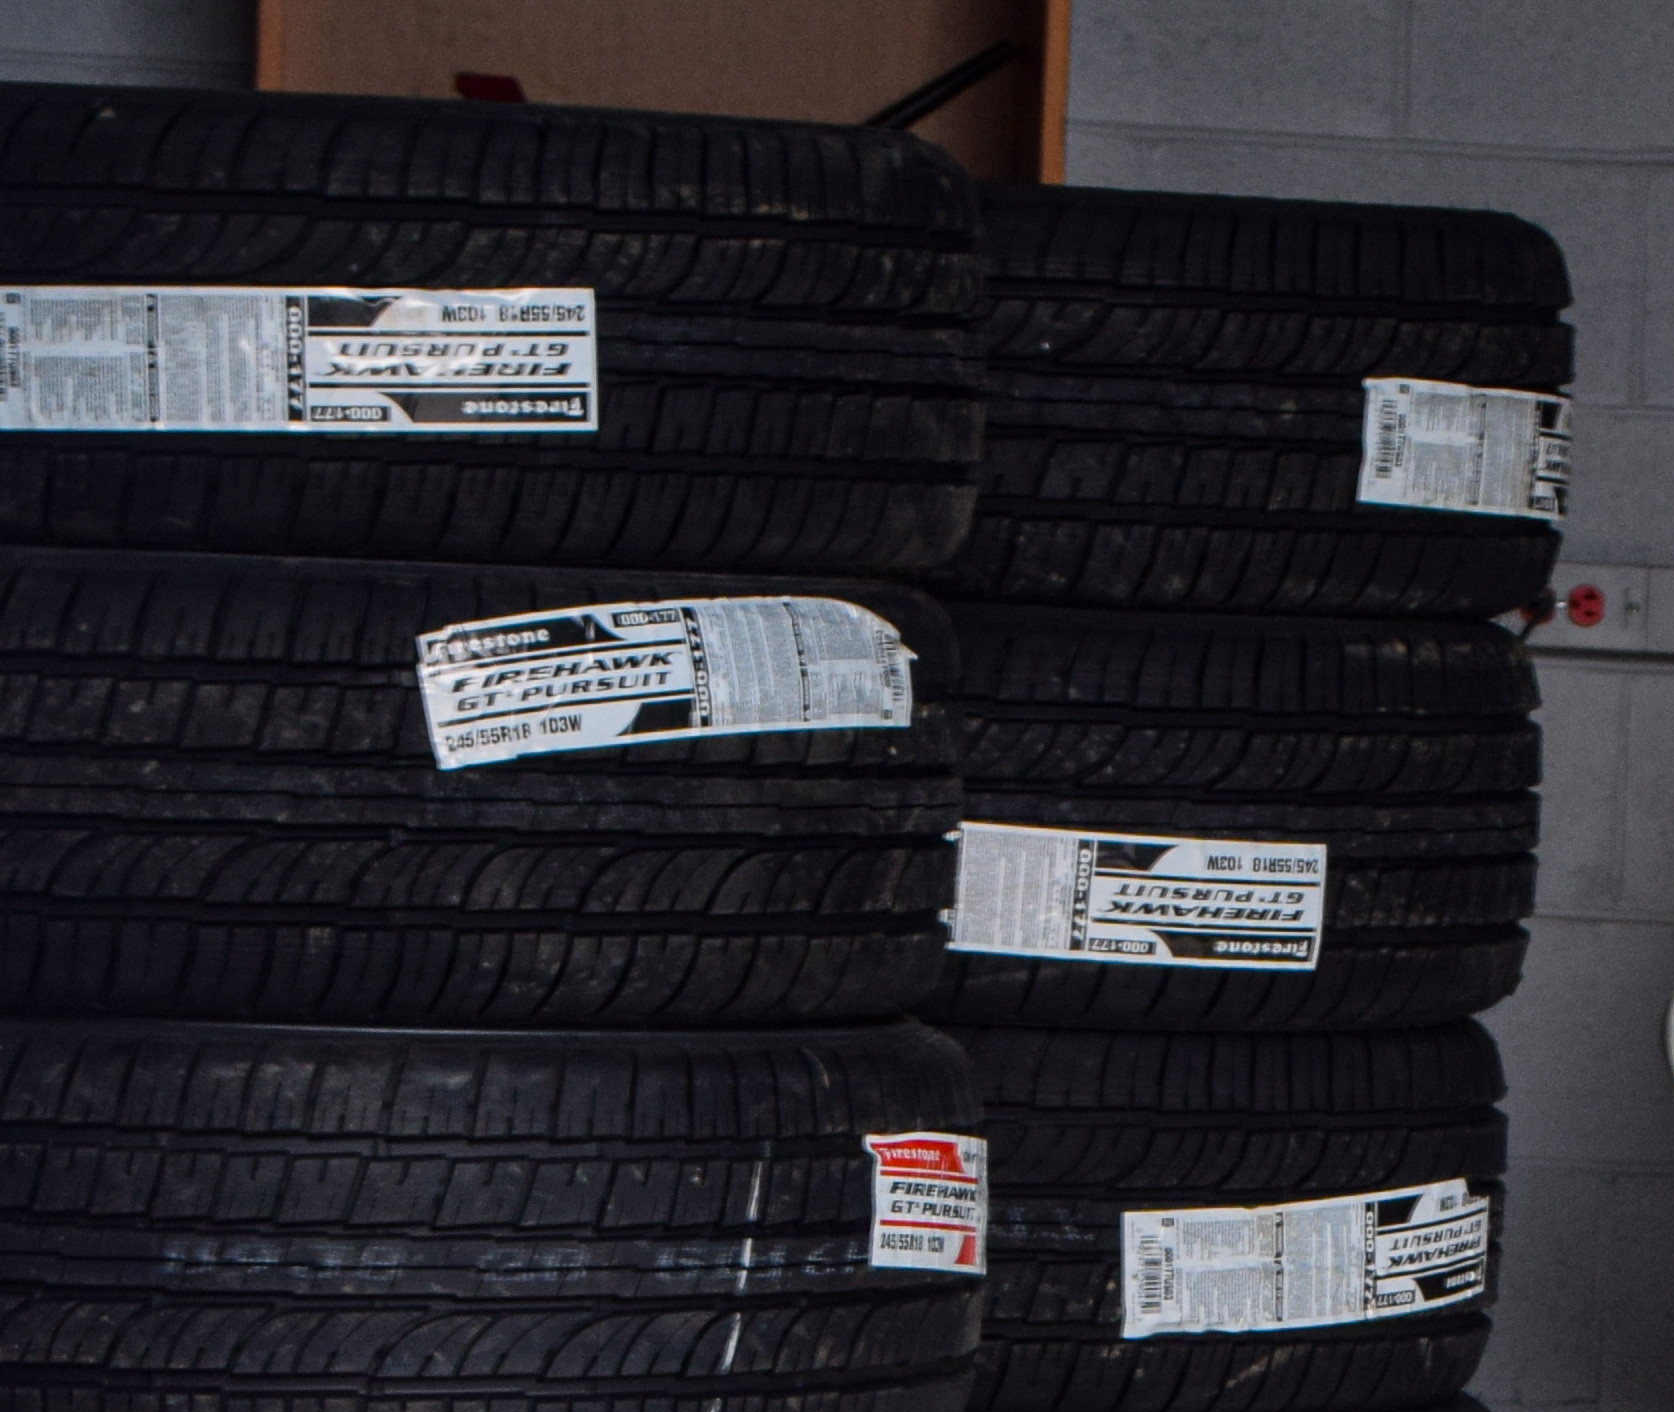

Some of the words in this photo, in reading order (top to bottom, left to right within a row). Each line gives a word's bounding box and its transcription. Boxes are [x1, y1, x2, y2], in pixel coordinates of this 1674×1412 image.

[336, 343, 504, 357] PURSUIT
[312, 406, 382, 419] 000-177
[461, 396, 584, 416] Firestone
[452, 652, 672, 692] FIREHAWK
[521, 671, 671, 701] PURSUIT
[540, 714, 582, 735] 103W
[1207, 856, 1242, 870] 103W
[1252, 857, 1319, 873] 245/55R18
[1071, 849, 1090, 939] 000-177
[1113, 884, 1254, 901] PURSUIT
[1106, 901, 1305, 921] FIREHAWK
[1091, 939, 1149, 951] 000-177
[1213, 941, 1308, 956] Firestone
[1390, 1226, 1462, 1250] PURSUIT
